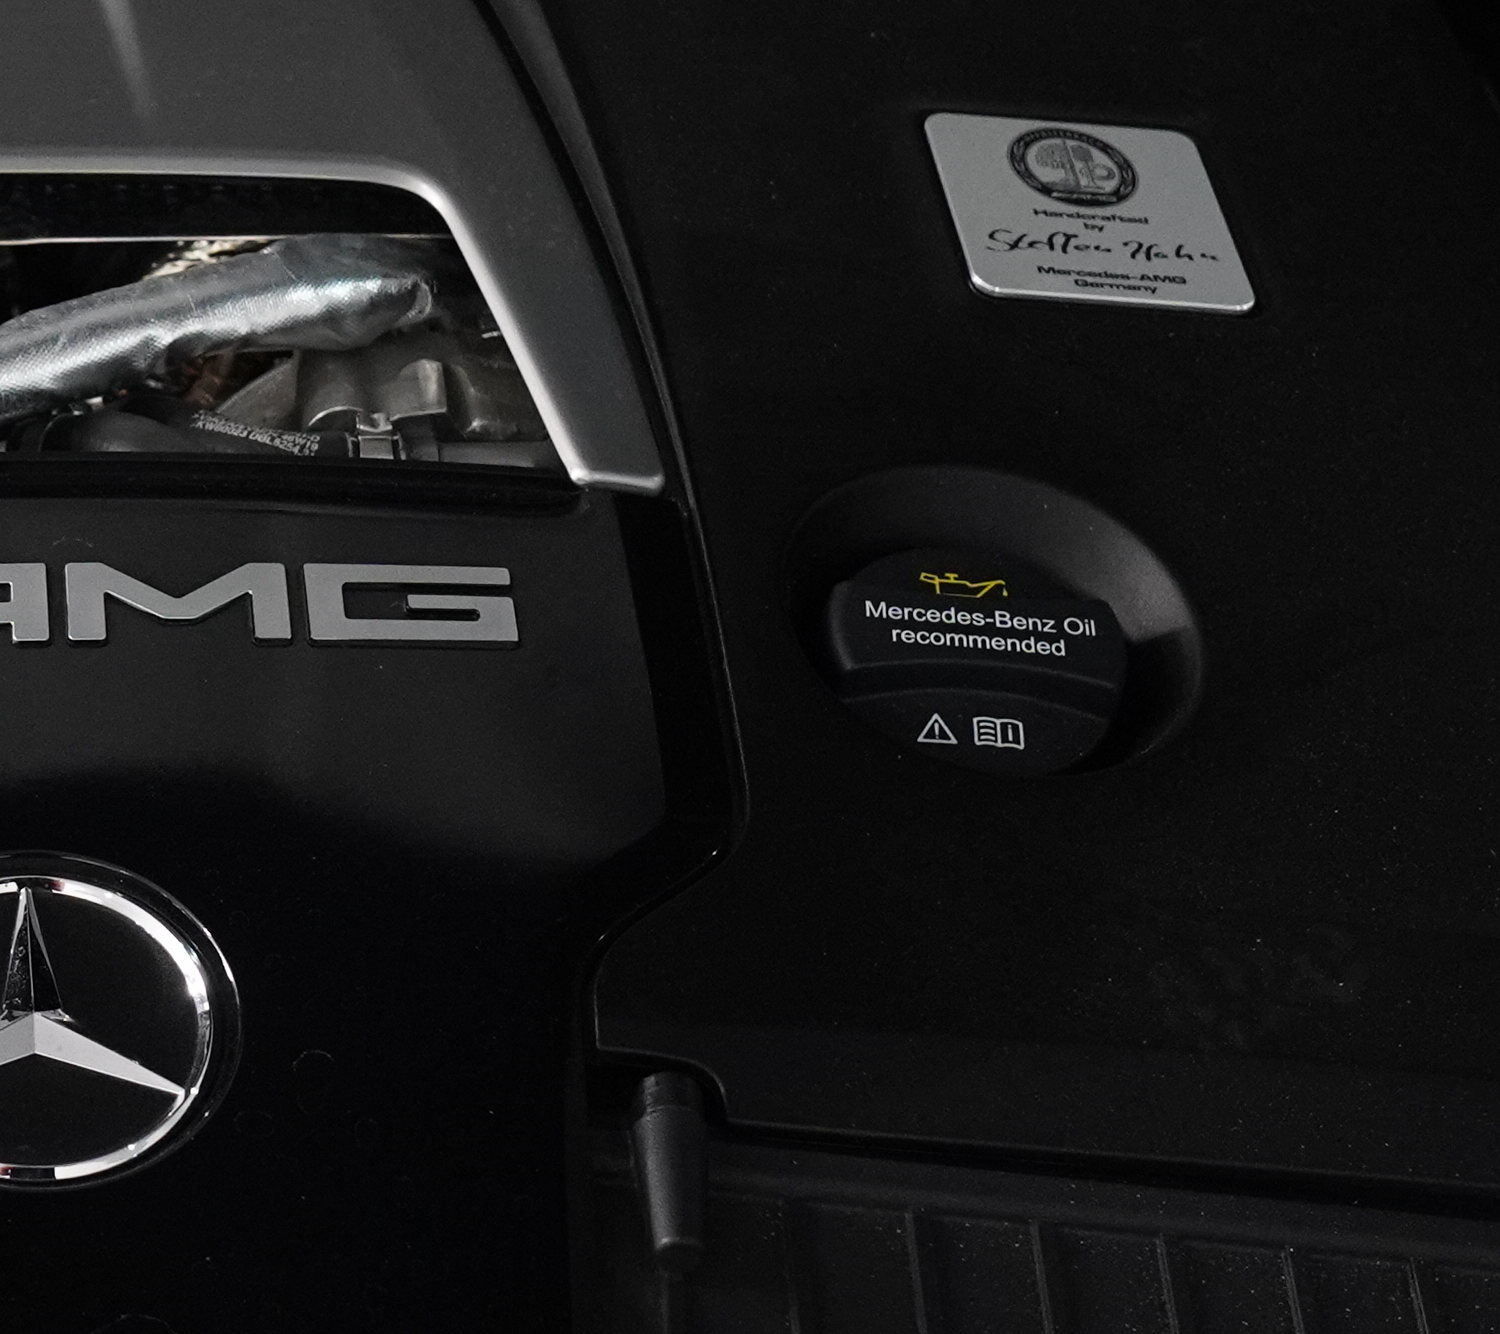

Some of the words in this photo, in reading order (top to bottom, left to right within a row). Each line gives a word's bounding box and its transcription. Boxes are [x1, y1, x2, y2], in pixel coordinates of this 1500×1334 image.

[1033, 208, 1149, 225] Handcrafted
[1082, 222, 1105, 233] by
[1036, 266, 1187, 285] Mercedes-AMG
[1074, 279, 1158, 295] Germany
[864, 600, 1058, 633] Mercedes-Benz
[1063, 617, 1097, 637] Oil
[891, 627, 1067, 657] recommended
